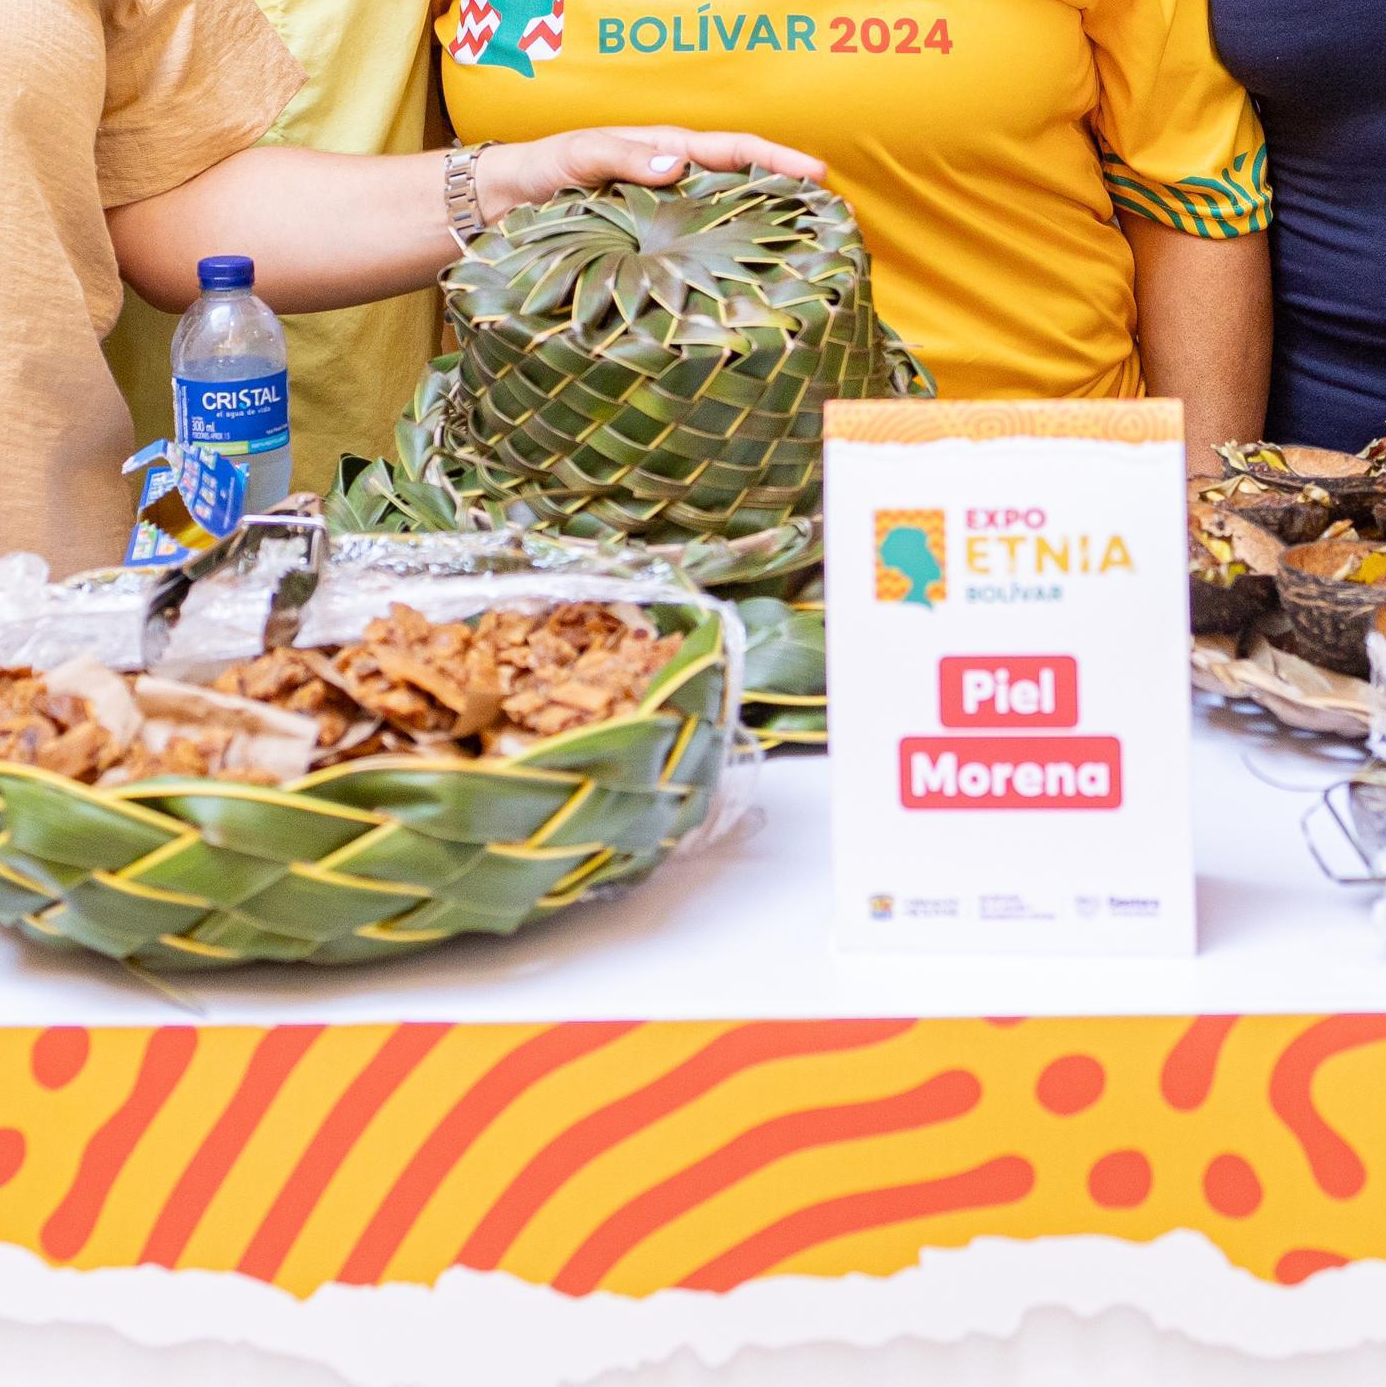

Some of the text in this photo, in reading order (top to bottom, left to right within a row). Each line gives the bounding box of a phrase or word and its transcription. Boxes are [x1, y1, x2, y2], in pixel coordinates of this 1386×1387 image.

[598, 3, 954, 55] BOLÍVAR 2024
[201, 384, 282, 411] CRISTAL
[191, 420, 205, 432] 300
[964, 509, 1047, 531] EXPO
[965, 535, 1139, 576] ETNIA
[965, 582, 1064, 605] BOLÍVAR
[960, 667, 1056, 716] Piel
[910, 752, 1112, 799] Morena
